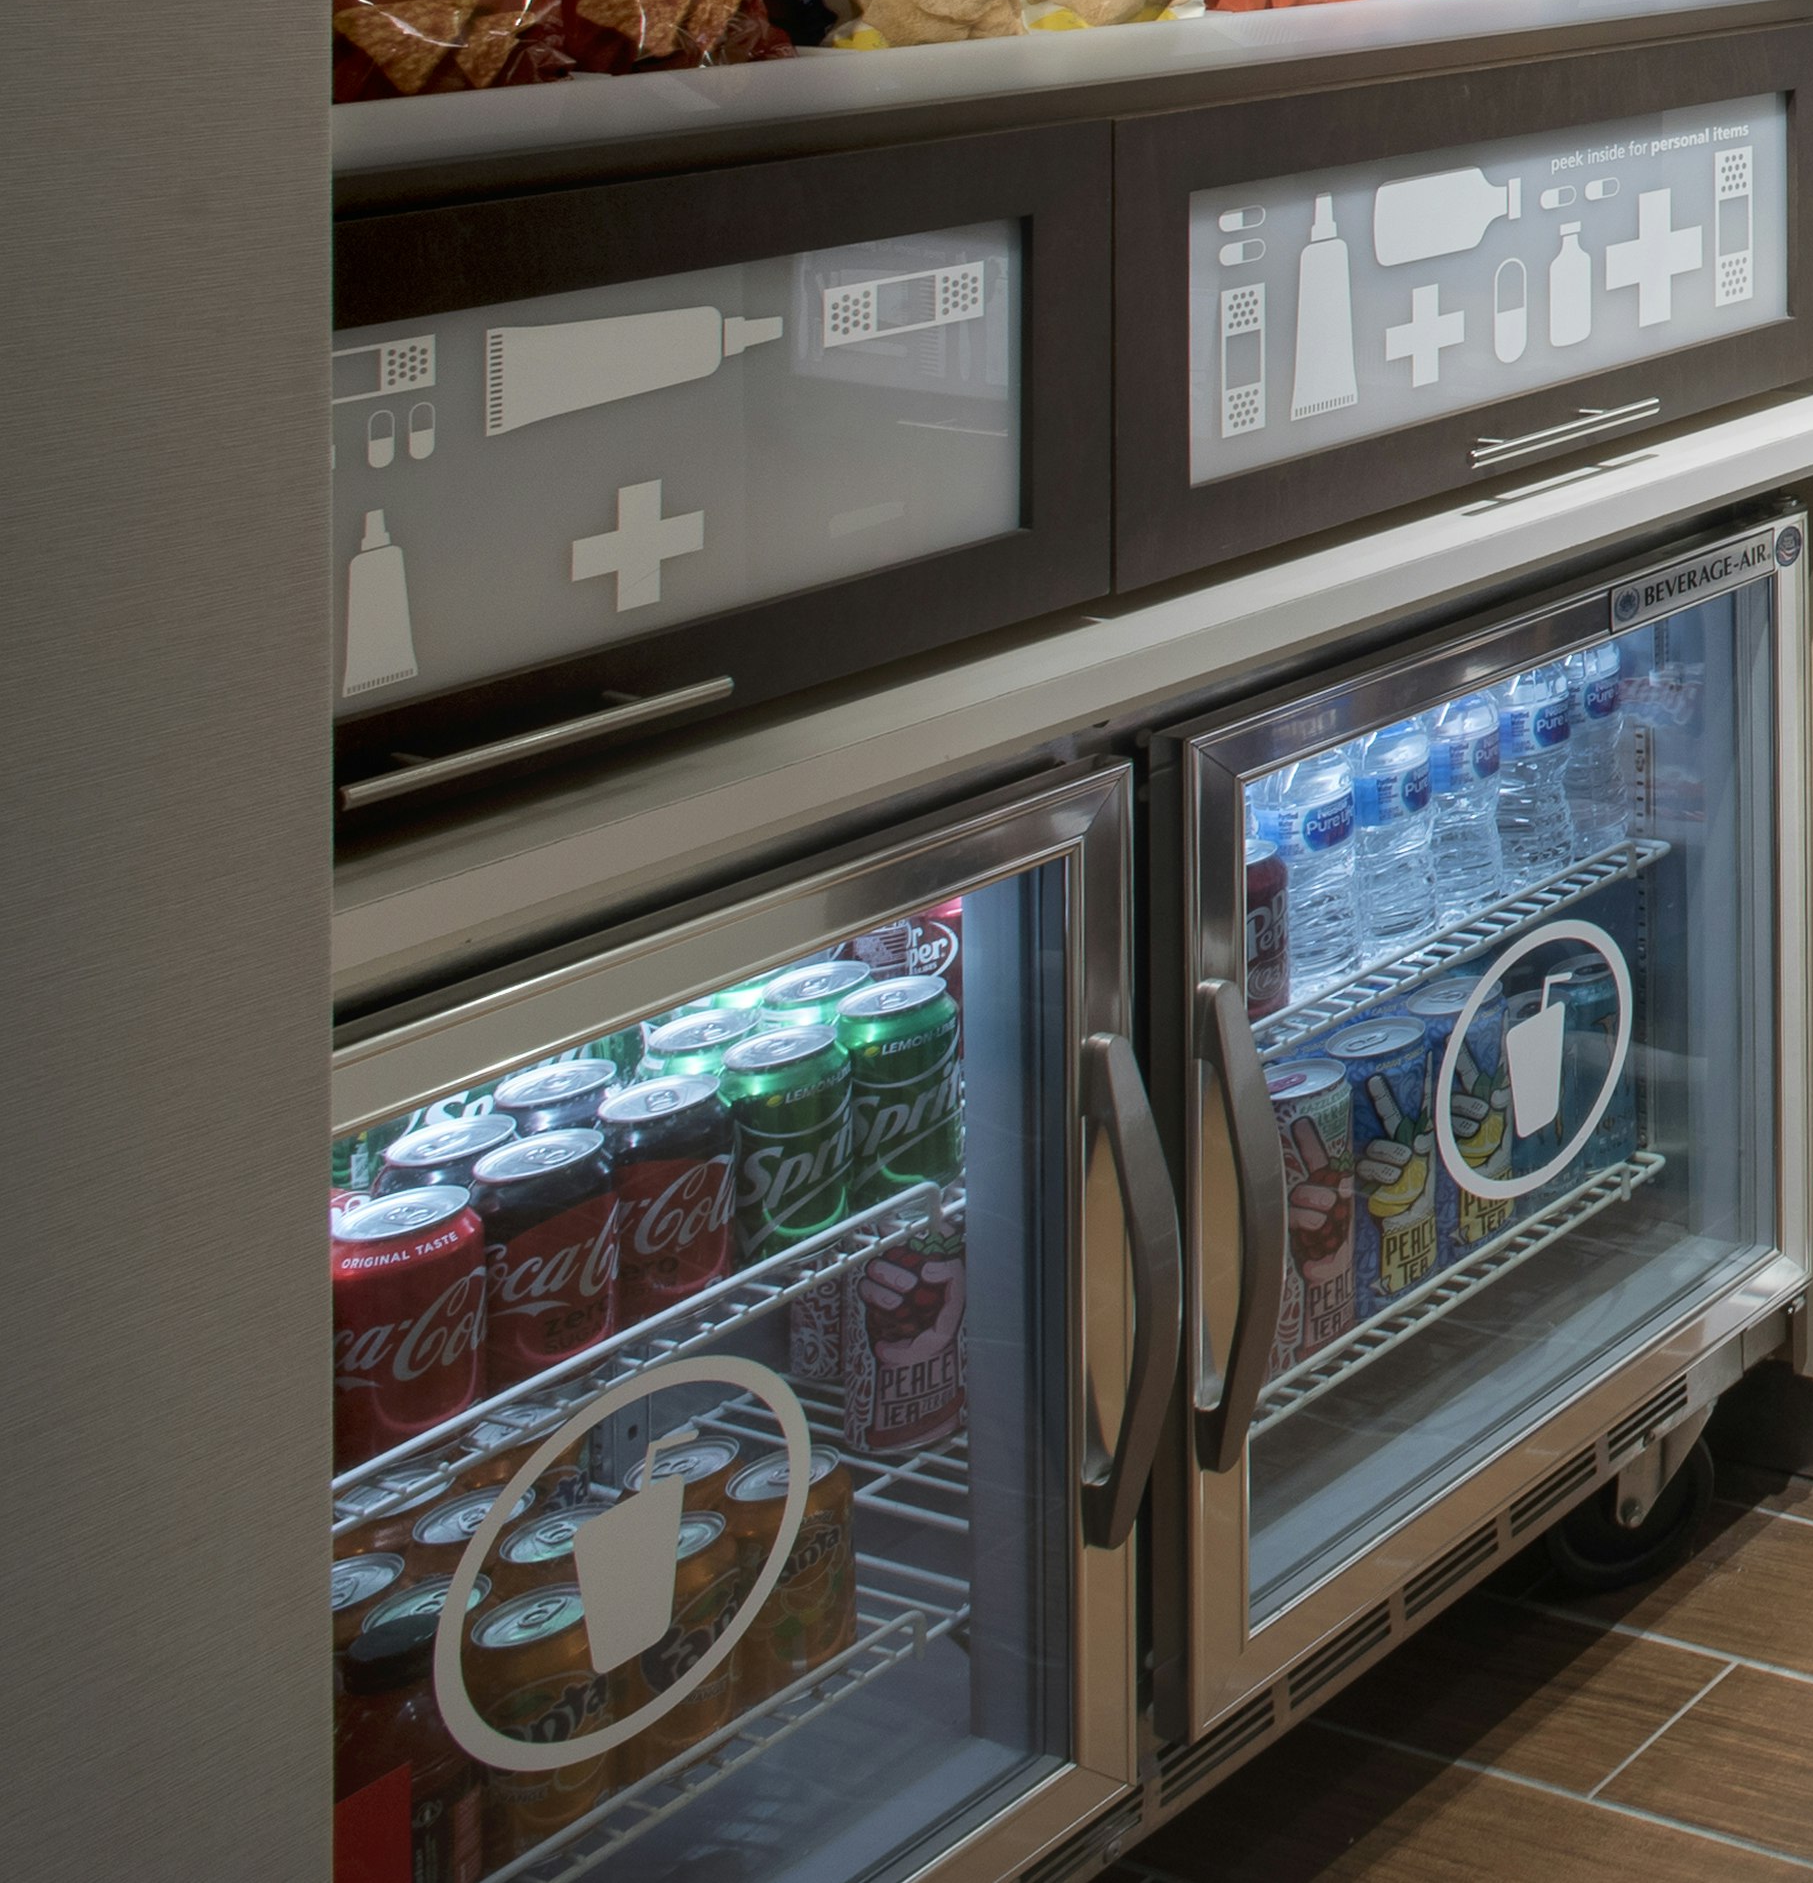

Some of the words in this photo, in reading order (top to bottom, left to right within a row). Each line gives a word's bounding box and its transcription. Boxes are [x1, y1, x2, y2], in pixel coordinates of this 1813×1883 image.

[1552, 151, 1584, 174] peek
[1588, 144, 1626, 165] inside
[1628, 140, 1649, 157] for
[1651, 128, 1710, 156] personal
[1713, 124, 1750, 142] items
[1644, 543, 1767, 607] BEVERAGE-AIR
[1306, 816, 1340, 837] Pure
[341, 1249, 410, 1270] ORIGINAL
[415, 1230, 459, 1256] TASTE
[1385, 1217, 1437, 1266] PEACE
[1401, 1255, 1431, 1287] TEA
[1311, 1309, 1343, 1340] TEA
[881, 1350, 953, 1401] PEACE
[882, 1400, 922, 1428] TEA
